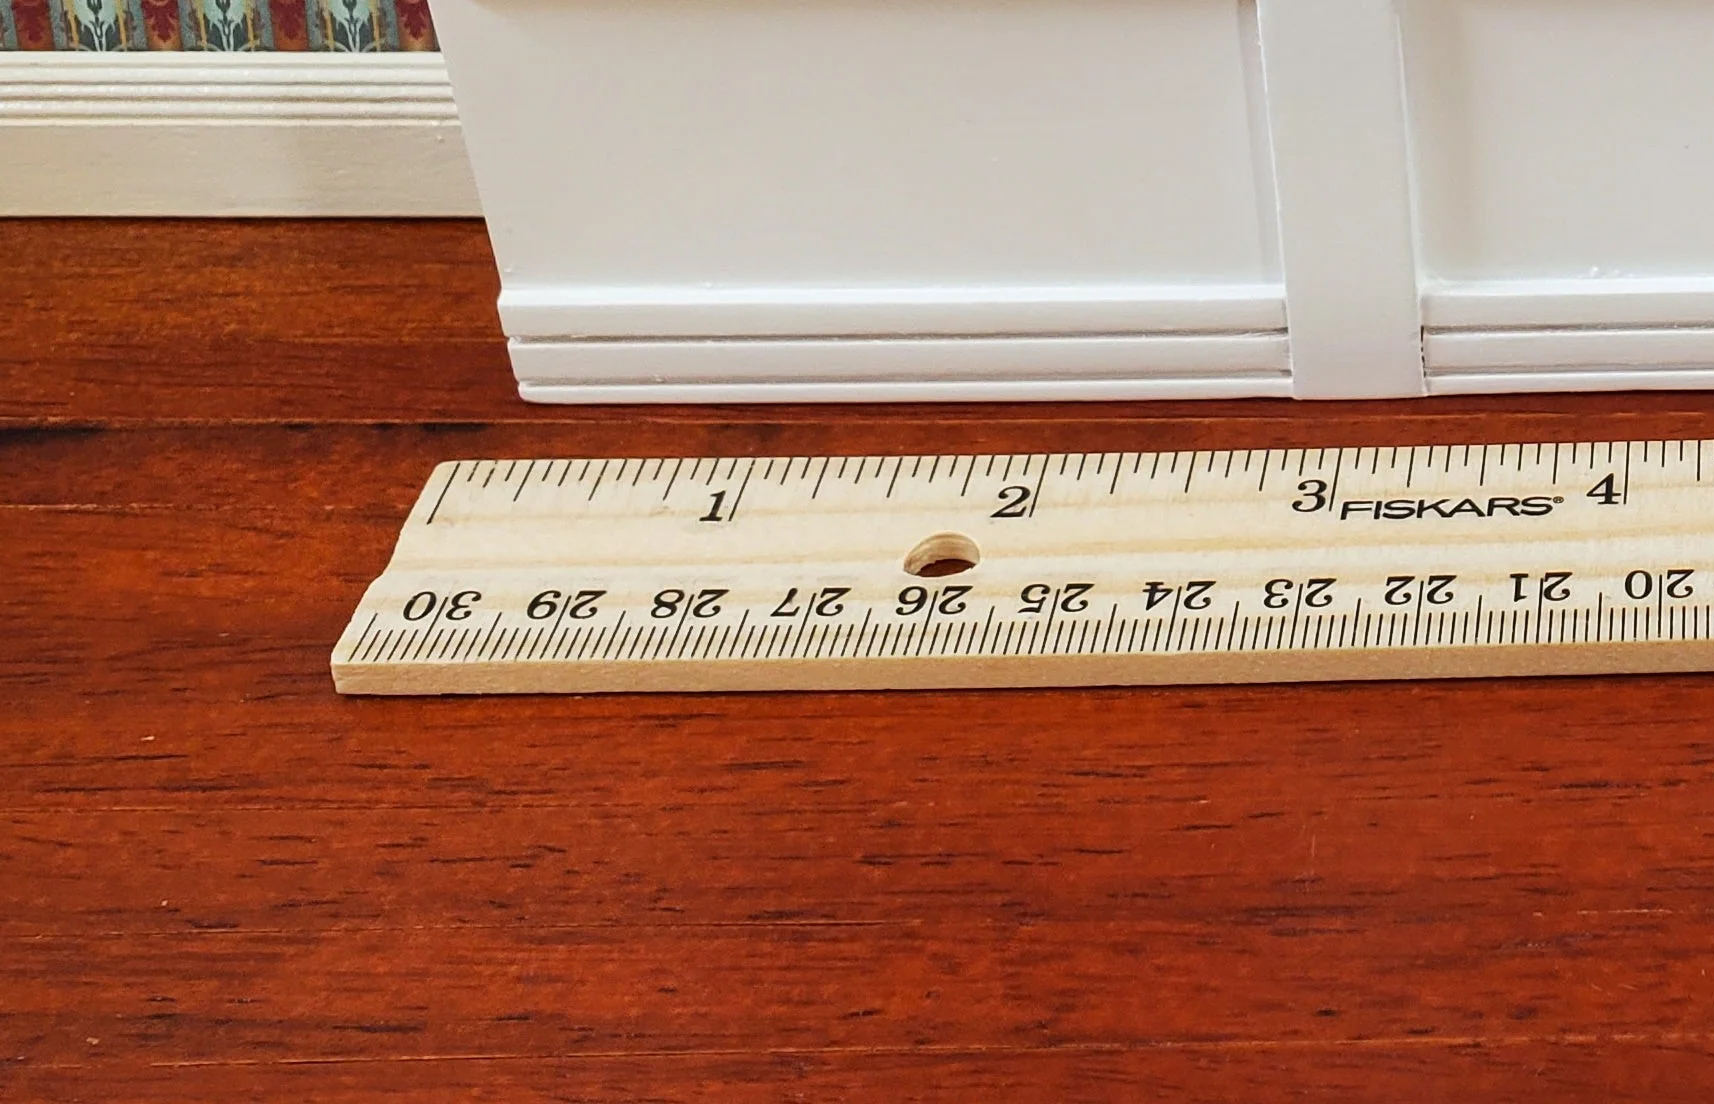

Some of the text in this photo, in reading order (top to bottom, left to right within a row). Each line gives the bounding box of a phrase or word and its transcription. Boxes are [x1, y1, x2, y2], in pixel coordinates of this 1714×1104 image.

[699, 490, 728, 522] 1
[990, 487, 1031, 518] 2
[1292, 480, 1327, 512] 3
[1586, 473, 1621, 505] 4
[1020, 583, 1095, 614] 25
[1143, 580, 1217, 610] 24
[1264, 578, 1337, 608] 23
[1384, 574, 1457, 606] 22
[1510, 572, 1572, 603] 21
[1625, 569, 1695, 599] 20
[403, 591, 482, 621] 30
[527, 589, 607, 620] 29
[650, 588, 729, 619] 28
[771, 587, 851, 617] 27
[896, 585, 973, 616] 26
